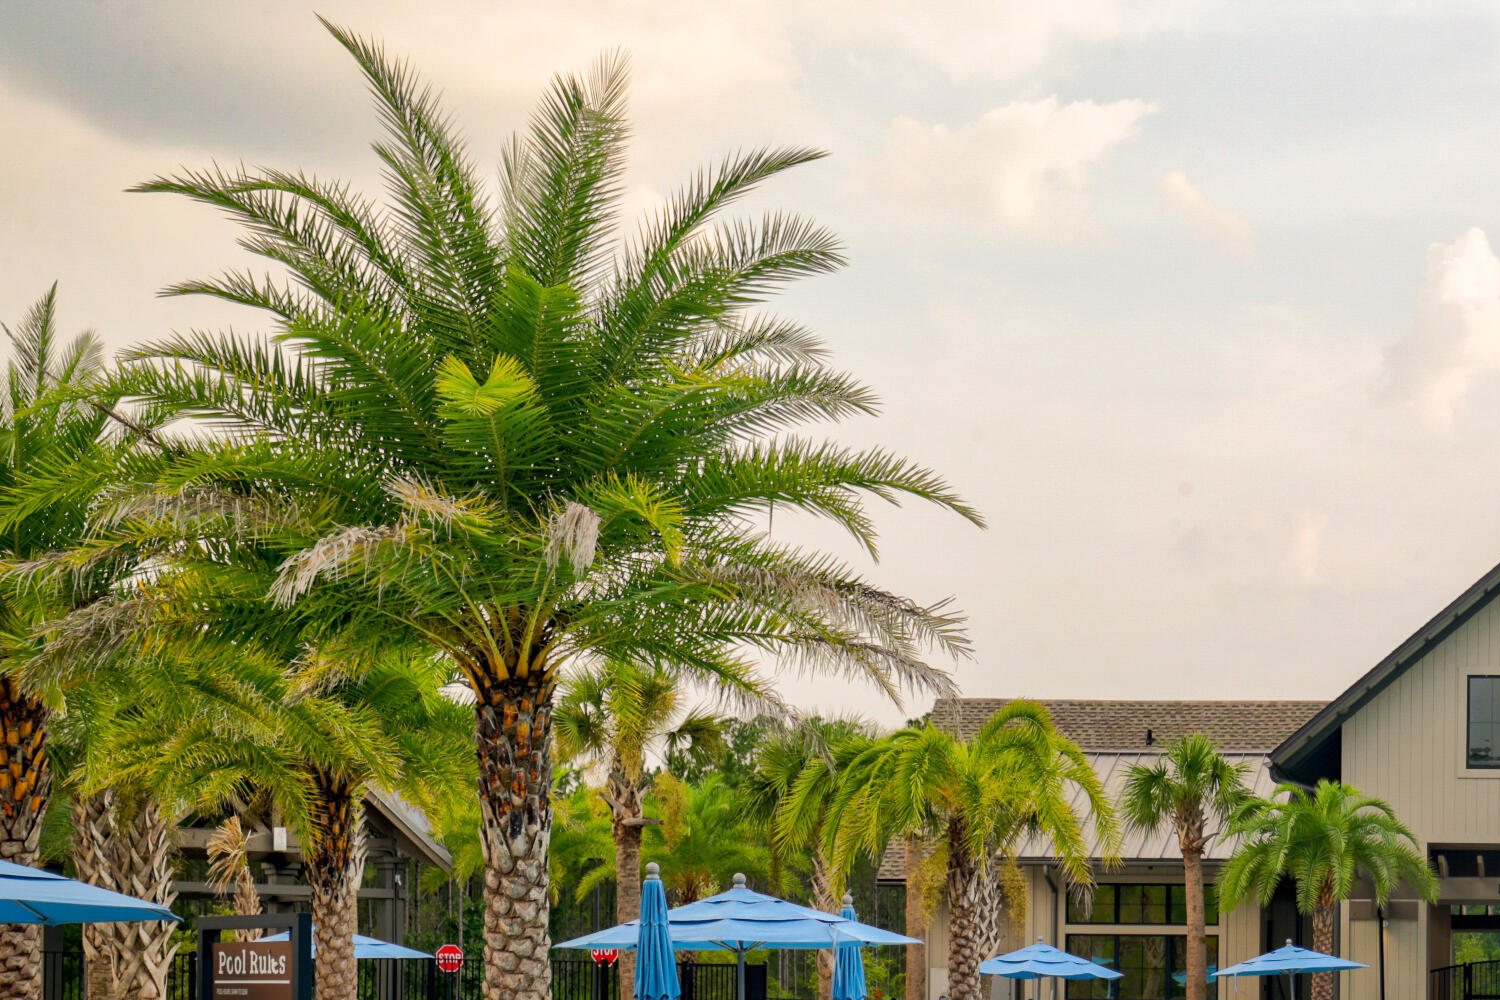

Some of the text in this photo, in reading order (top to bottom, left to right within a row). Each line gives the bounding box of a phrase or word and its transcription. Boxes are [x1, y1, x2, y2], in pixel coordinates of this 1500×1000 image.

[218, 949, 286, 975] Pool Rules
[438, 953, 461, 963] STOP
